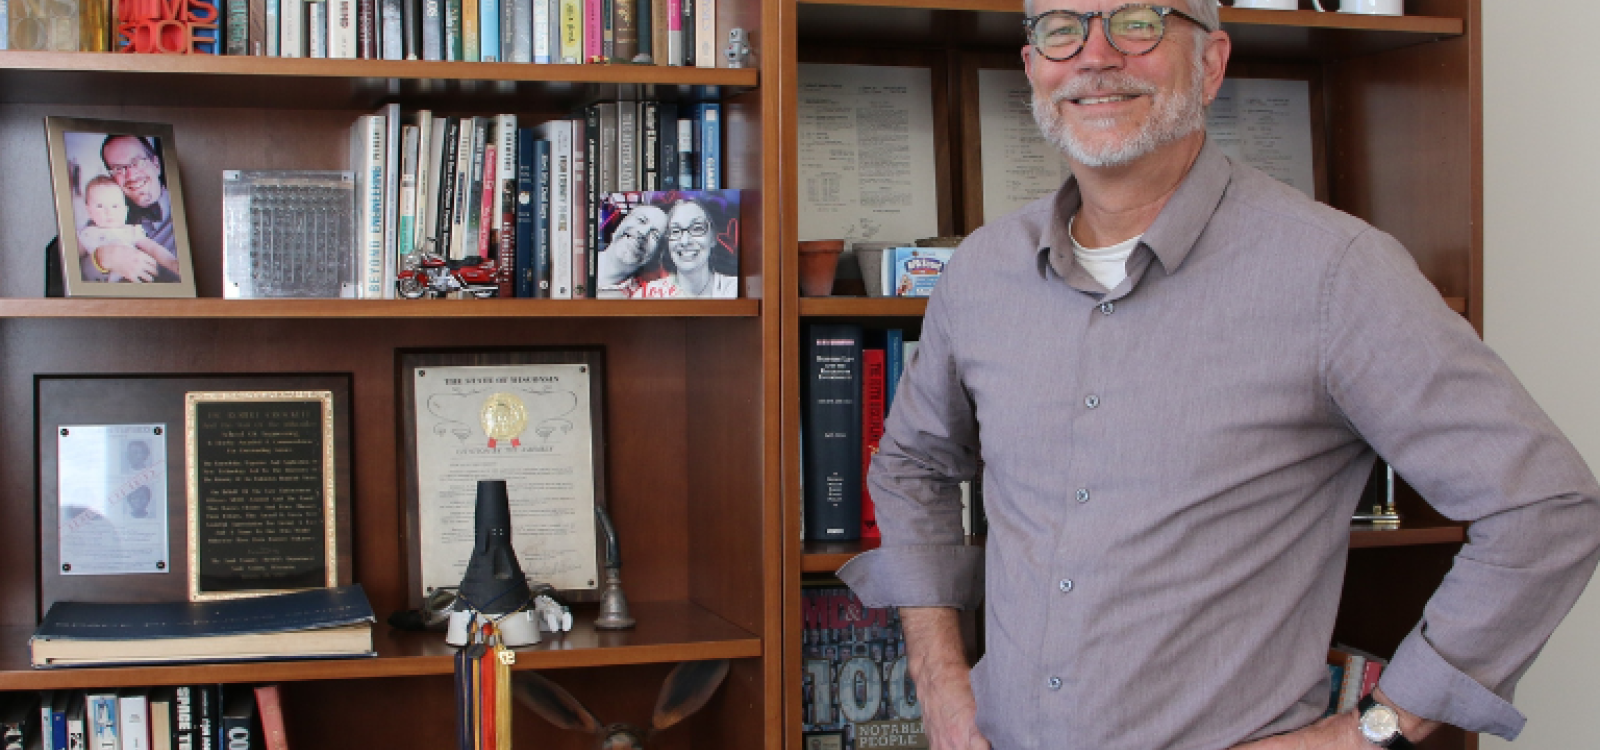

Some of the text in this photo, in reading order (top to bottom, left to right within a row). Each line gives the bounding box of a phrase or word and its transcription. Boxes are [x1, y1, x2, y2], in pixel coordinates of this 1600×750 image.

[369, 240, 381, 292] BEYOND
[869, 362, 882, 442] THE FIFTH DISCIPLINE
[176, 686, 192, 731] SPACE
[858, 734, 918, 749] PEOPLE
